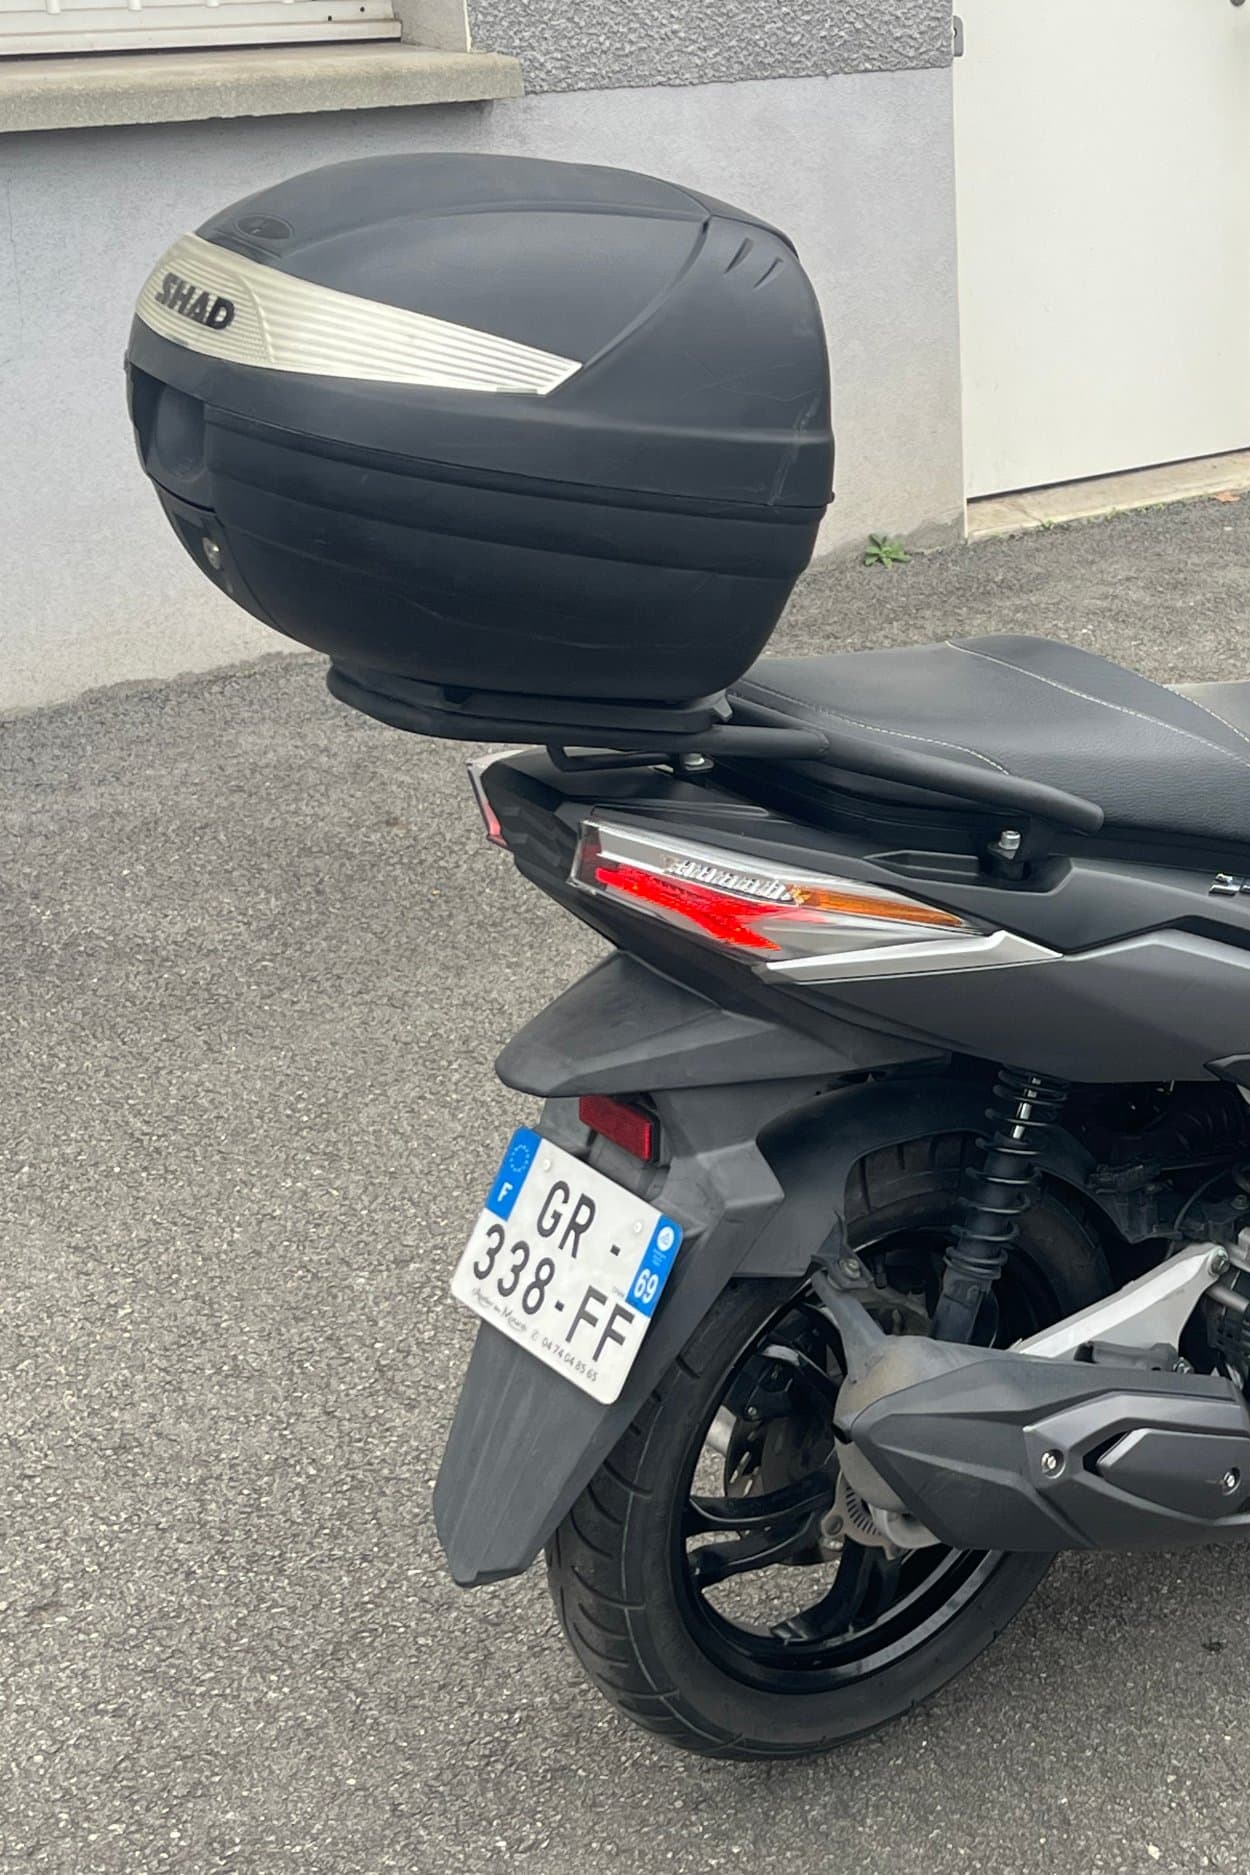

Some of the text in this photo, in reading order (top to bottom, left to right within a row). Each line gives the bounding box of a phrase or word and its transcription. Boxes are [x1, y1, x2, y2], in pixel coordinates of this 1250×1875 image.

[155, 272, 235, 331] SHAD
[497, 1182, 513, 1202] F
[634, 1268, 659, 1304] 69
